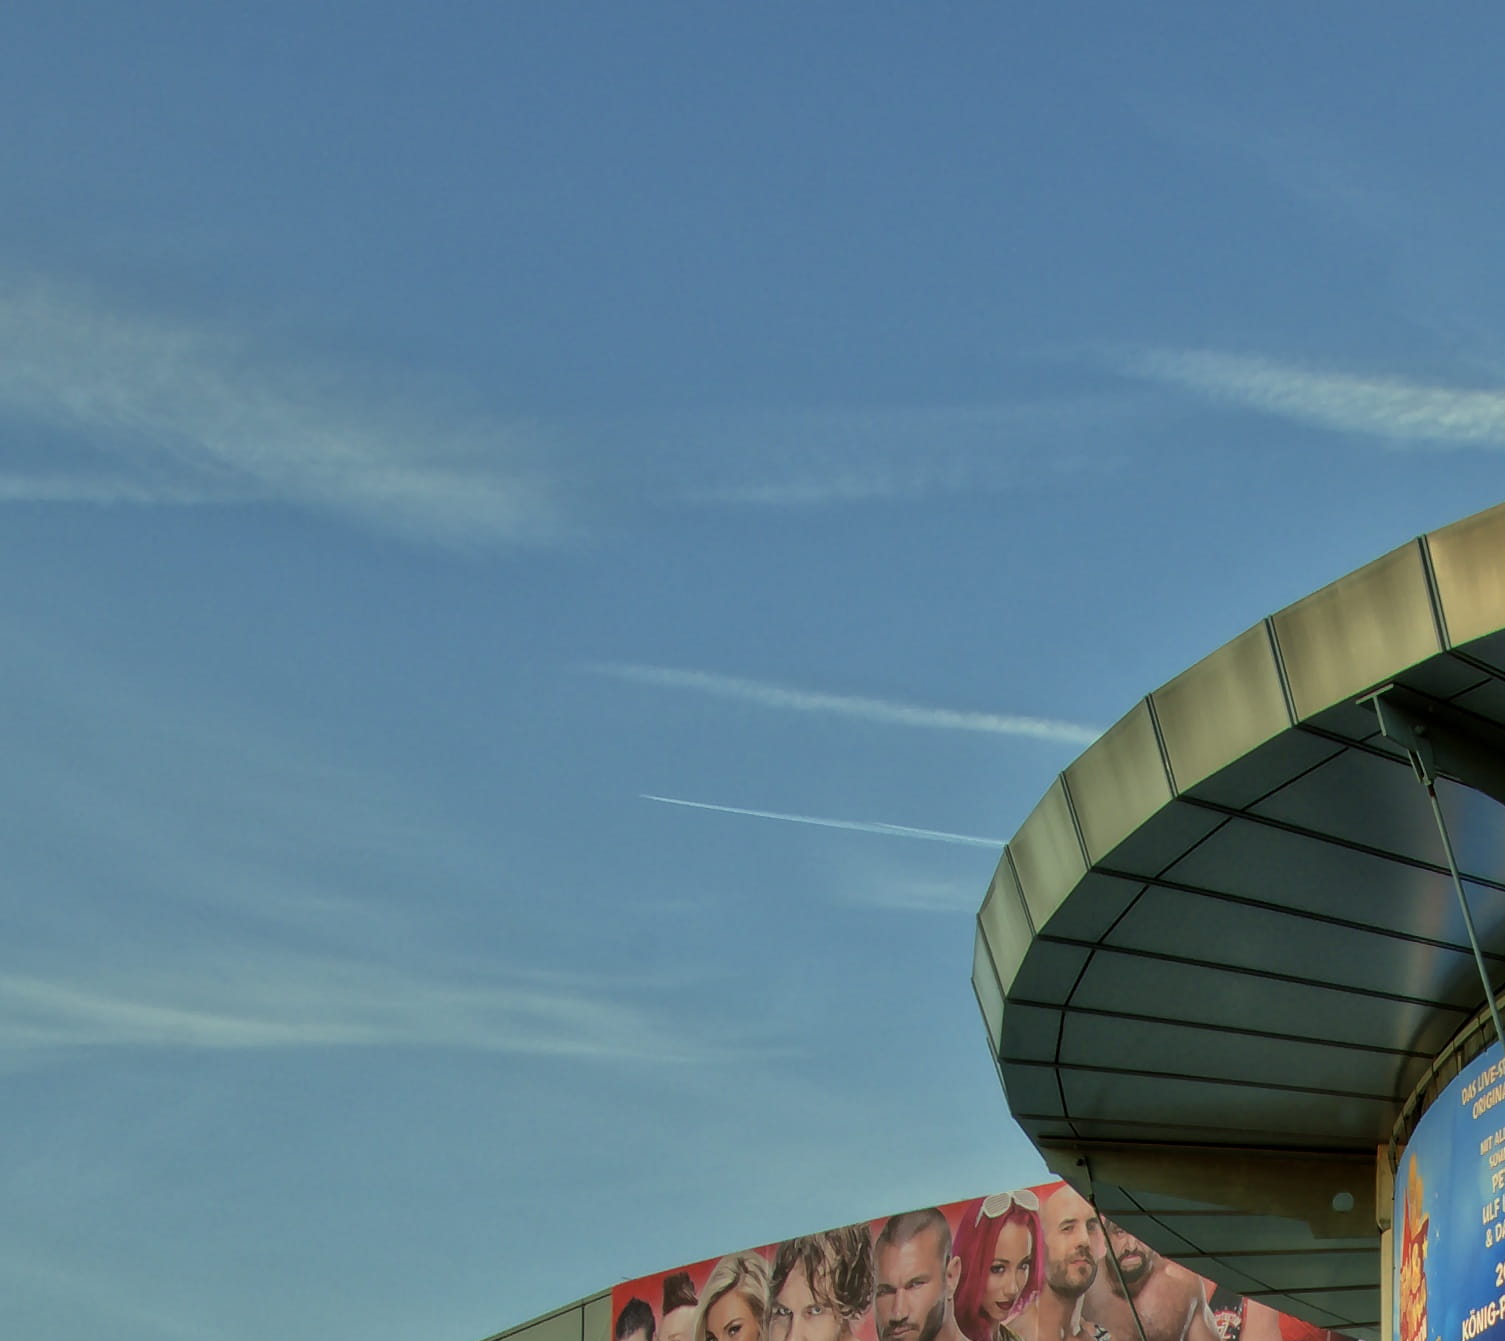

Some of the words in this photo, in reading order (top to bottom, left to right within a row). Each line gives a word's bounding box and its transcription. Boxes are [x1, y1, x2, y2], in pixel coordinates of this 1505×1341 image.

[1461, 1080, 1476, 1105] DAS
[1482, 1197, 1500, 1225] ULF
[1485, 1228, 1493, 1248] &
